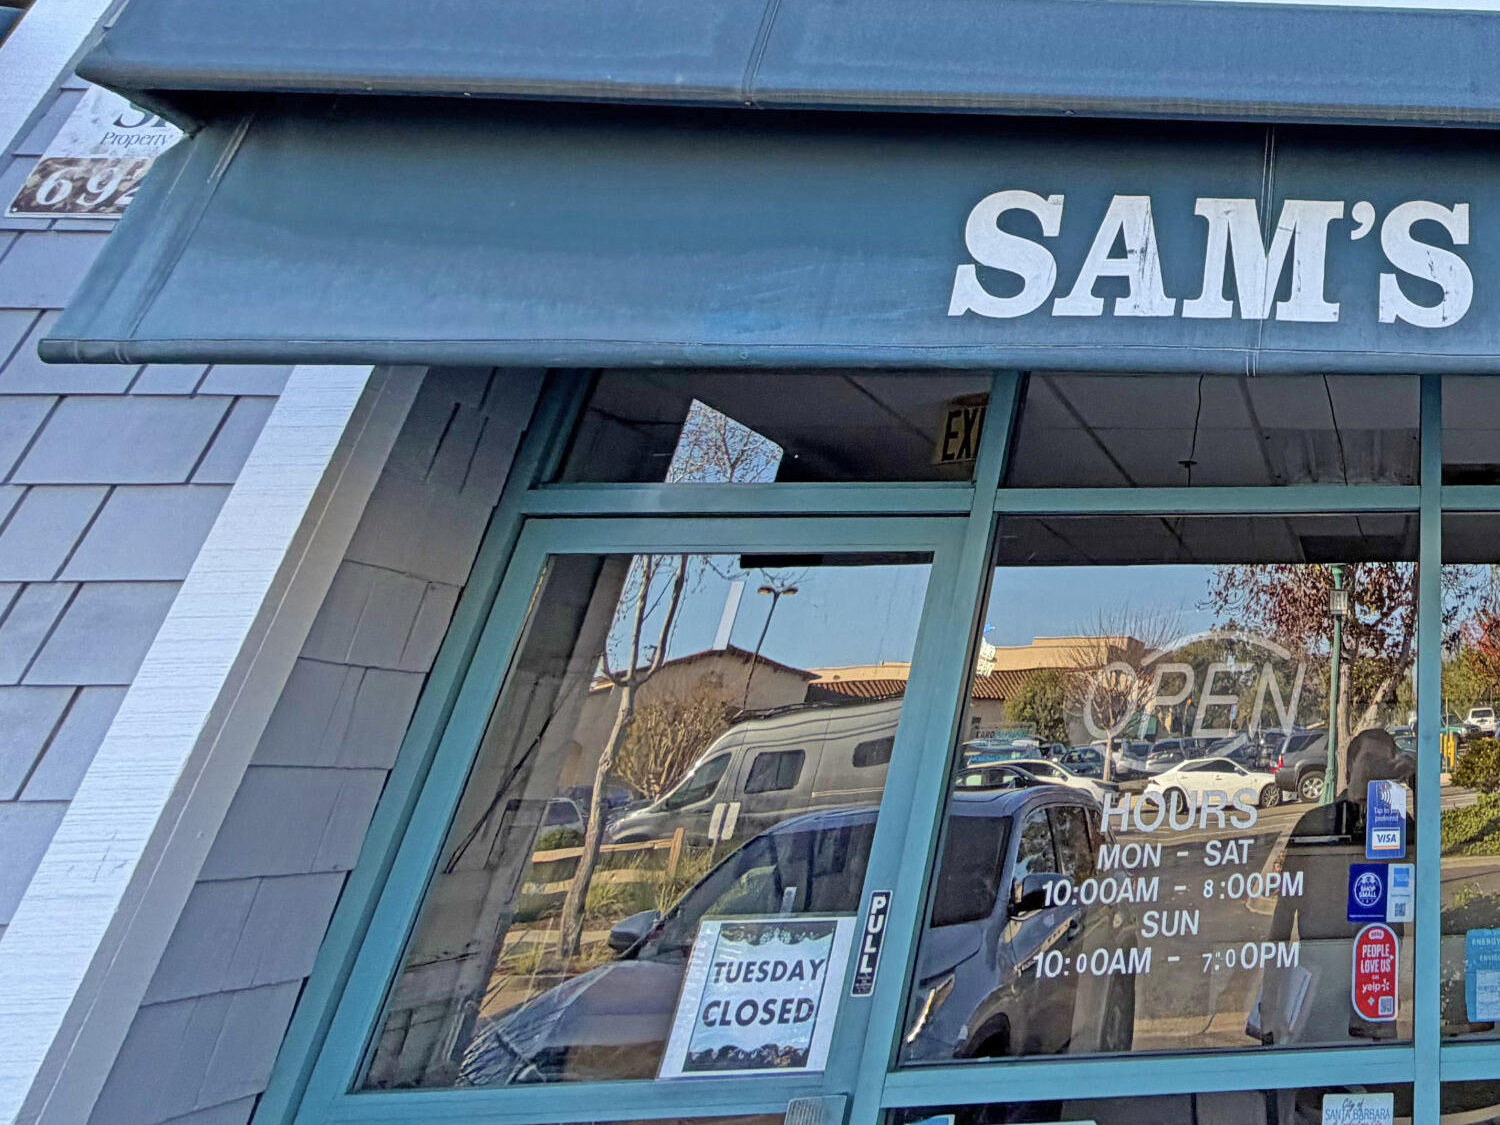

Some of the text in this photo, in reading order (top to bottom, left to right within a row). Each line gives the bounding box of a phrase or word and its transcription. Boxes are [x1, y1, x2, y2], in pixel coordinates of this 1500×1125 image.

[100, 131, 169, 149] Property
[947, 190, 1475, 328] SAM'S
[941, 406, 987, 462] EXI
[1081, 661, 1306, 741] OPEN
[1099, 787, 1258, 834] HOURS
[1376, 833, 1397, 844] VISA
[1096, 842, 1162, 871] MON
[1203, 838, 1255, 867] SAT
[1041, 876, 1160, 907] 10:00AM
[858, 895, 888, 974] PULL
[1140, 909, 1200, 939] SUN
[1033, 947, 1152, 979] 10:00AM
[1362, 943, 1390, 958] PEOPLE
[713, 958, 827, 984] TUESDAY
[1360, 958, 1391, 974] LOVE US
[1362, 980, 1381, 994] yelp
[702, 996, 816, 1027] CLOSED
[1325, 1107, 1391, 1121] SANTA BARBARA
[1342, 1097, 1356, 1112] City
